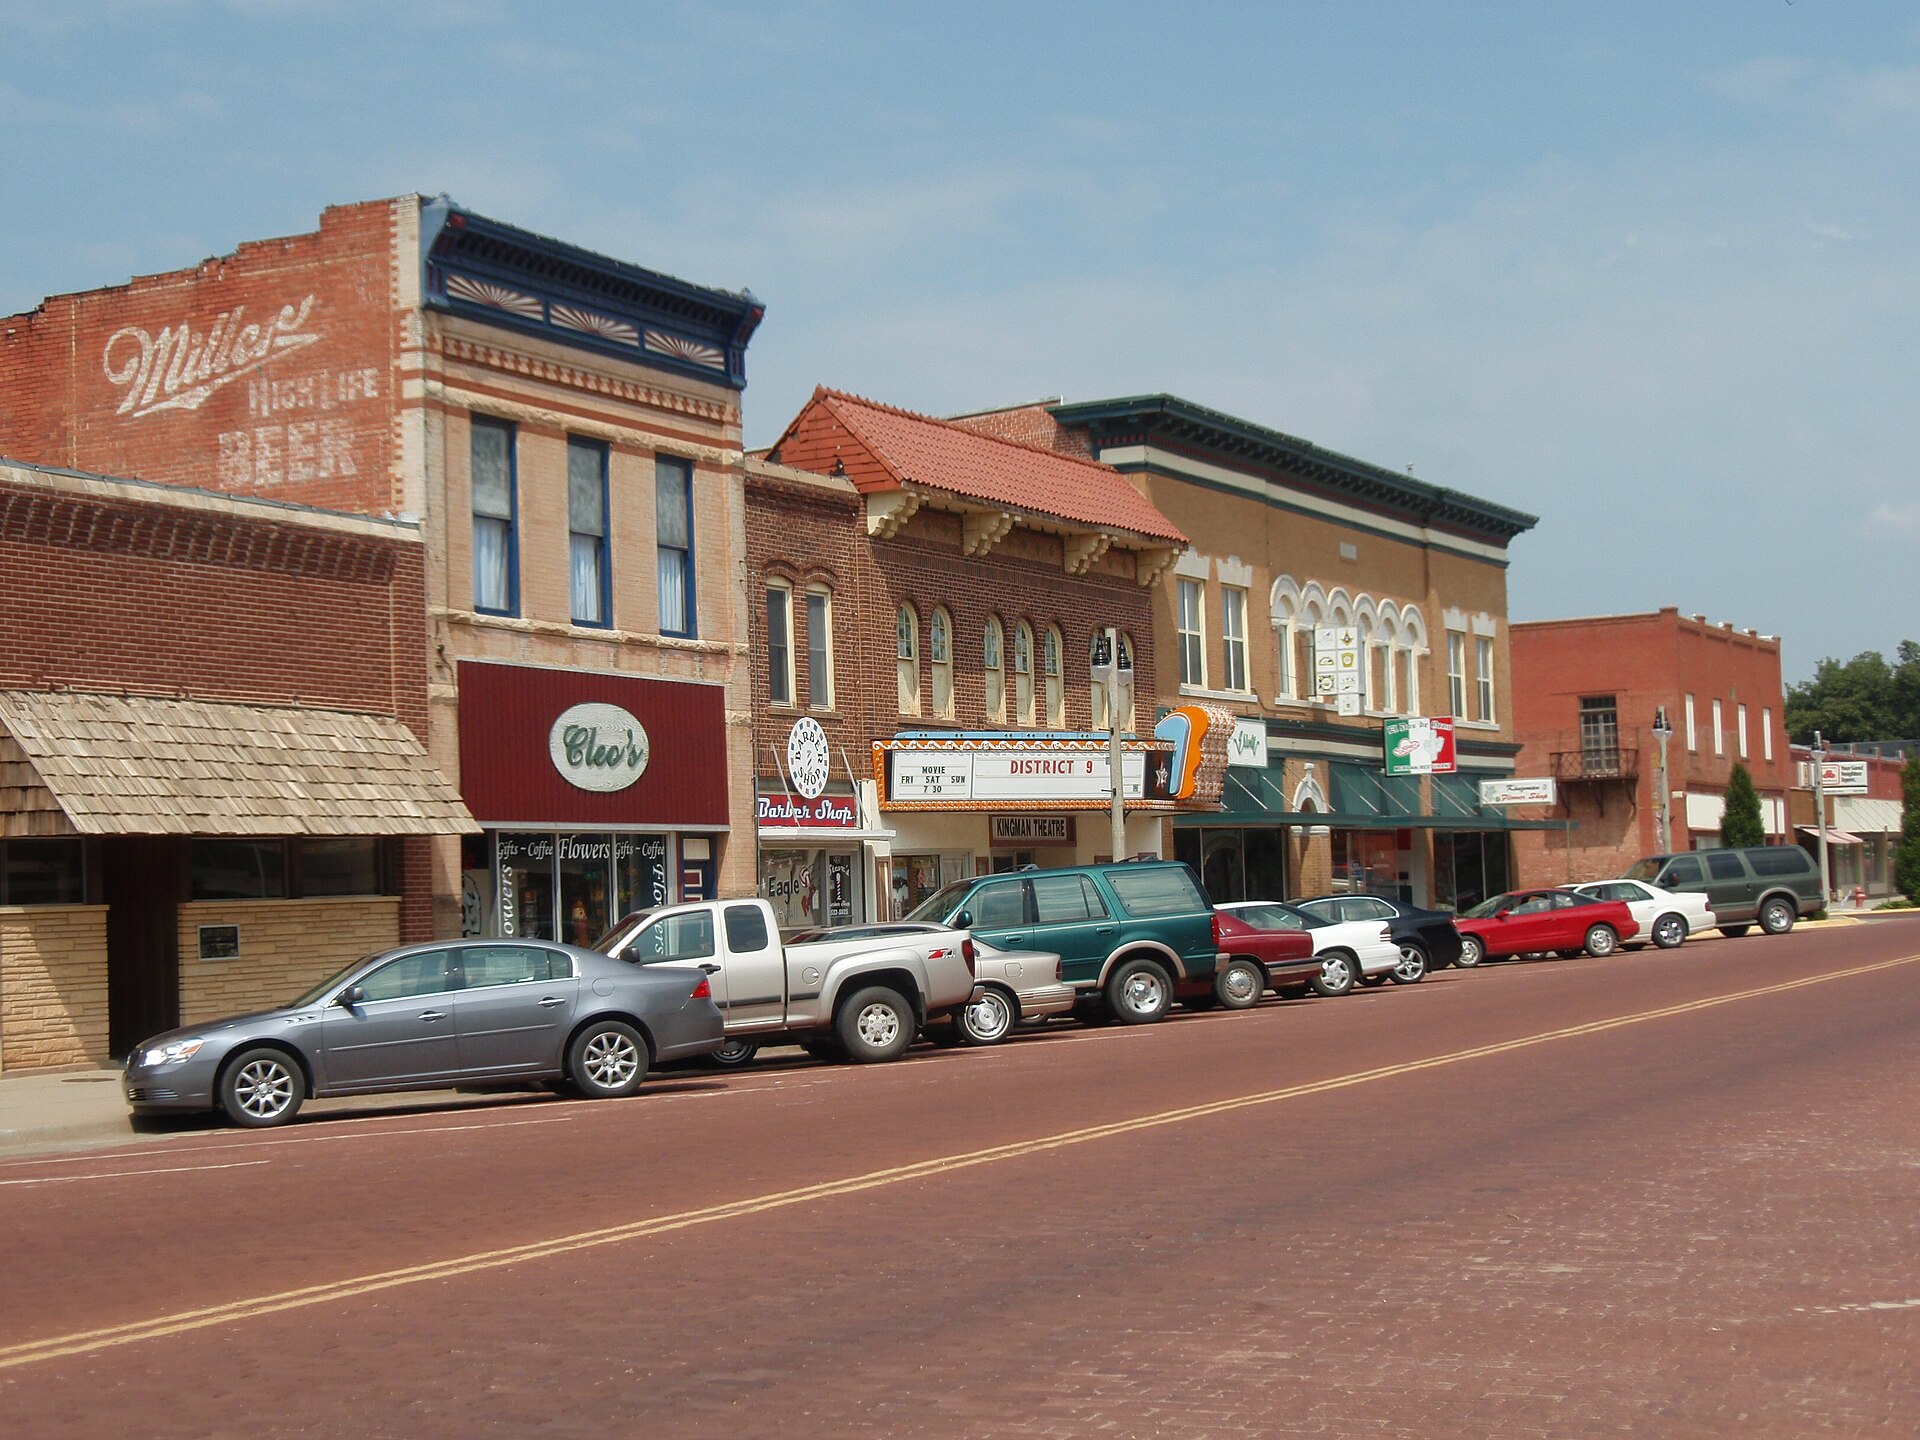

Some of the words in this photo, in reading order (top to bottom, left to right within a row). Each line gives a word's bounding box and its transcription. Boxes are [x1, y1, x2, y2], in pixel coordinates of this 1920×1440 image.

[104, 294, 325, 417] Miller
[319, 366, 379, 410] LIFE
[218, 418, 358, 489] BEER
[563, 724, 645, 769] Cleo's
[795, 730, 824, 764] BARBER
[797, 766, 821, 786] SHOP
[922, 766, 946, 775] MOVIE
[1010, 760, 1074, 775] DISTRICT
[1086, 760, 1093, 775] 9
[901, 776, 914, 785] FRI
[925, 776, 941, 785] SAT
[951, 776, 966, 784] SUN
[924, 785, 929, 794] 7
[932, 785, 942, 794] 30
[758, 797, 811, 819] Barber
[815, 799, 853, 824] Shop
[996, 817, 1032, 837] KINGMAN
[1033, 819, 1065, 837] THEATRE
[498, 841, 518, 860] Gifts
[528, 841, 553, 860] Coffee
[559, 835, 610, 859] Flowers
[615, 841, 634, 860] Gifts
[642, 840, 665, 860] Coffee
[768, 870, 800, 905] Eagle
